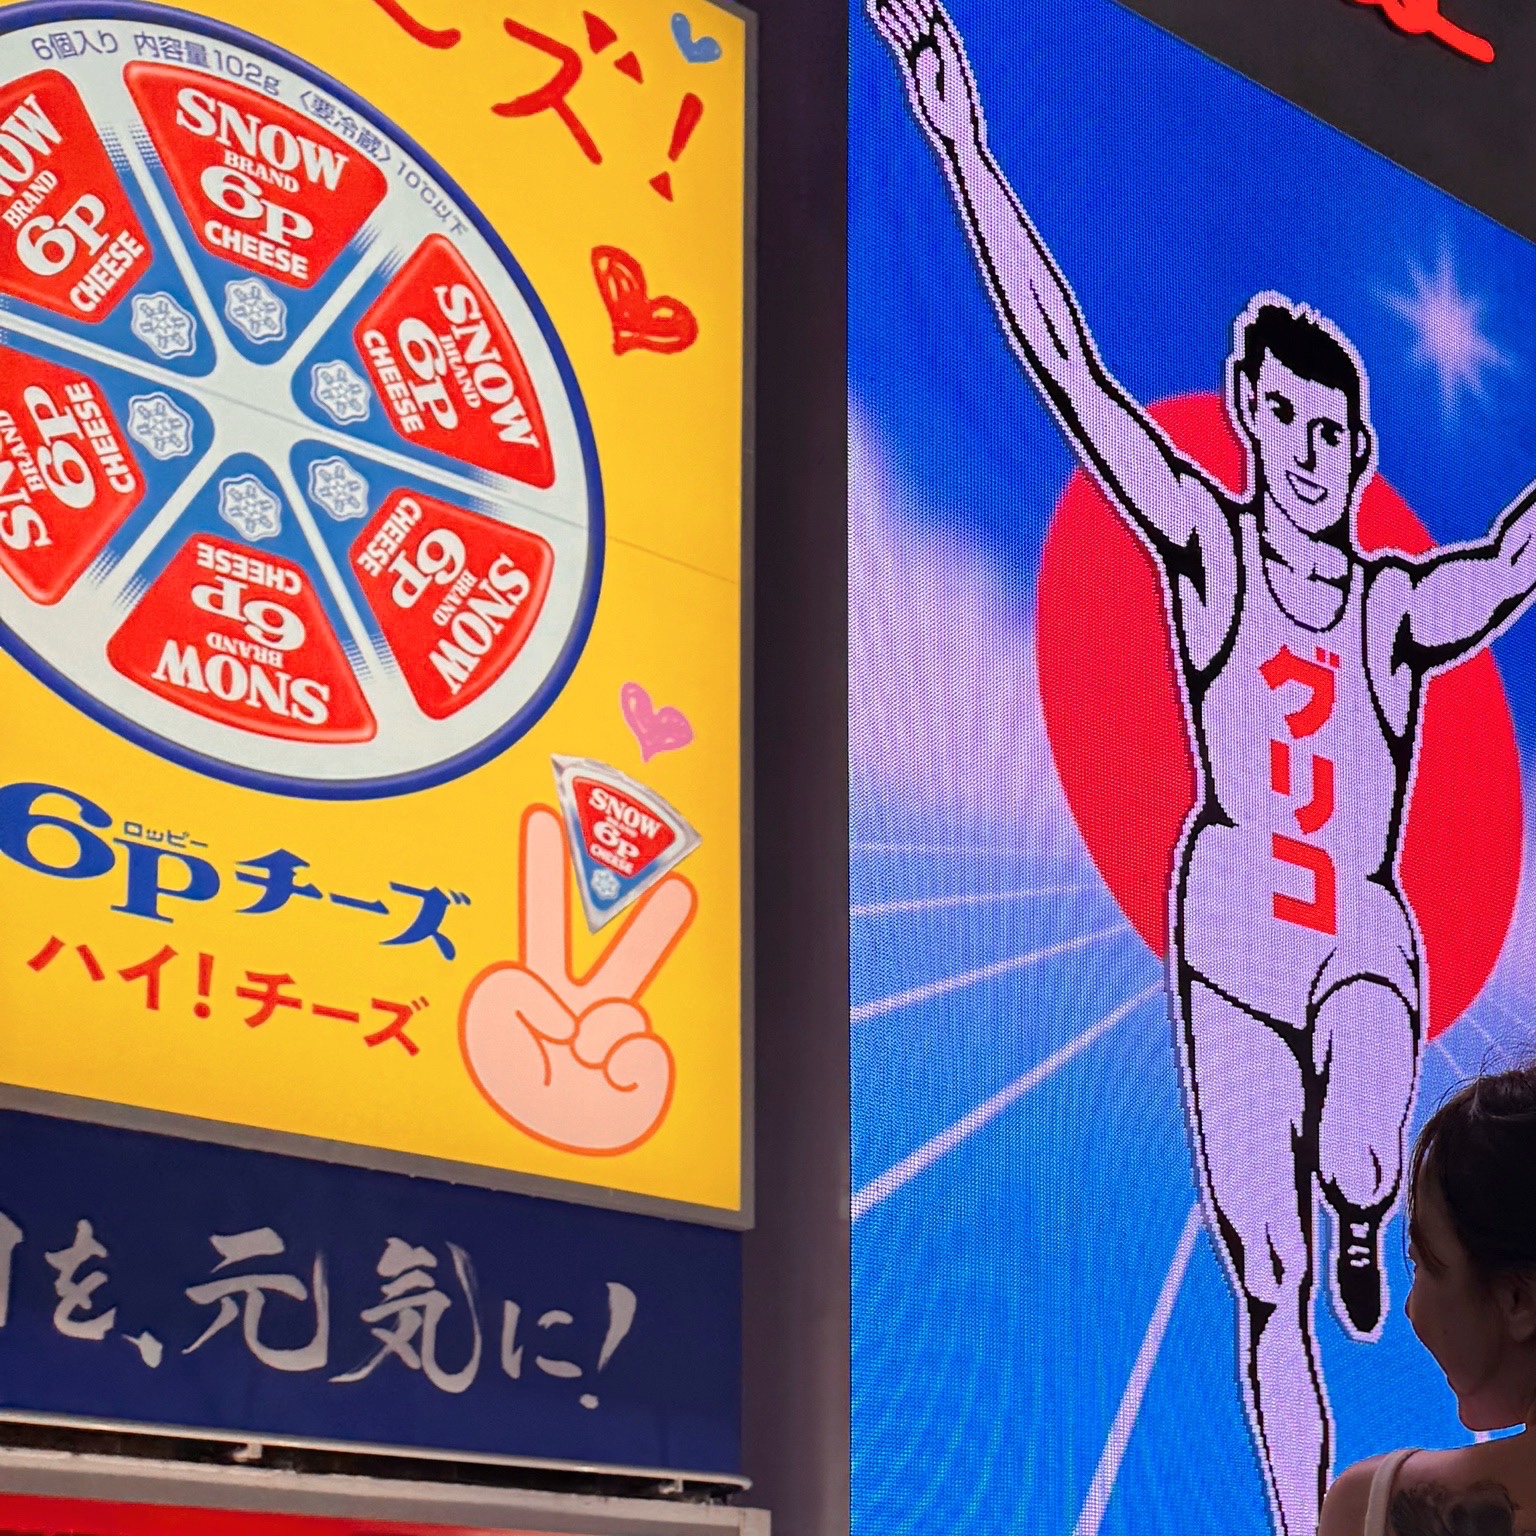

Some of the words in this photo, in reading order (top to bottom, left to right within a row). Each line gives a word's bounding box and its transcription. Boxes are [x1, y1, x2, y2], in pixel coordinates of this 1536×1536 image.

[31, 30, 118, 61] 6個入り
[134, 33, 281, 97] 内容量102g
[176, 87, 349, 192] SNOW
[223, 149, 300, 193] BRAND
[1, 170, 59, 230] BRAND
[69, 230, 145, 313] CHEESE
[204, 219, 309, 280] CHEESE
[362, 328, 426, 434] CHEESE
[433, 283, 541, 449] SNOW
[438, 333, 481, 409] BRAND
[64, 380, 137, 494] CHEESE
[196, 541, 302, 596] CHEESE
[356, 496, 423, 578] CHEESE
[428, 552, 531, 696] SNOW
[431, 568, 478, 627] BRAND
[150, 639, 330, 726] SNOW
[205, 631, 284, 669] BRAND
[588, 787, 662, 840] SNOW
[1258, 644, 1341, 936] グリコ
[123, 820, 209, 849] ロッピー
[27, 935, 430, 1057] ハイ!チーズ
[0, 1192, 638, 1410] を、元気に!
